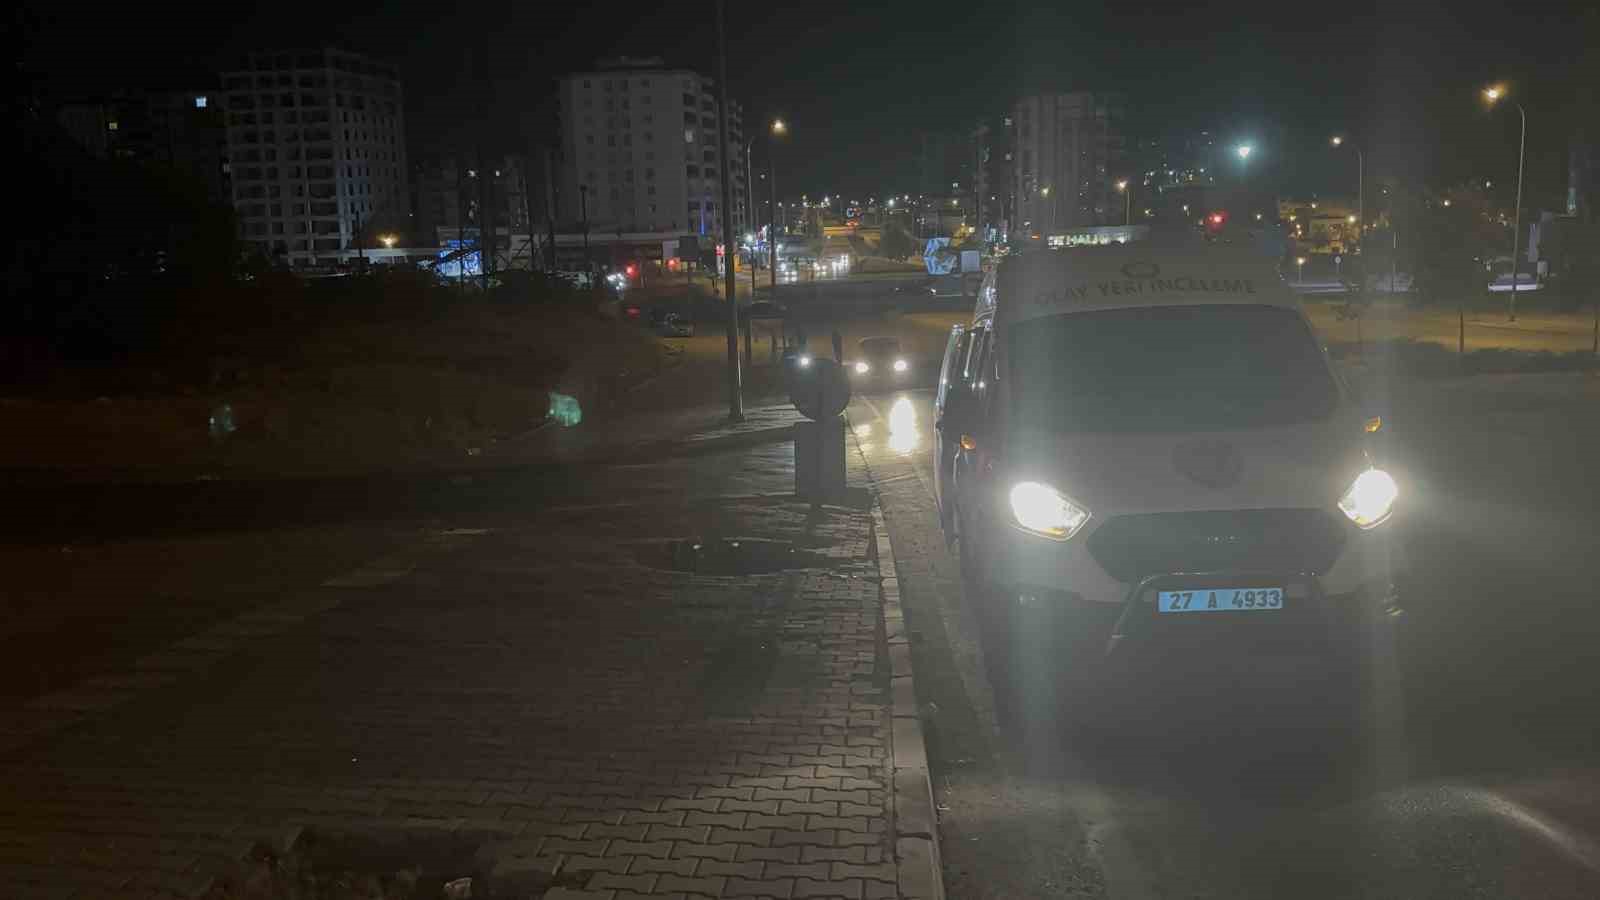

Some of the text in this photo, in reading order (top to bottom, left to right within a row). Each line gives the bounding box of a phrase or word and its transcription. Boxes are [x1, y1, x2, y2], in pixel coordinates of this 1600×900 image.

[1169, 589, 1280, 610] 27 A 4933
